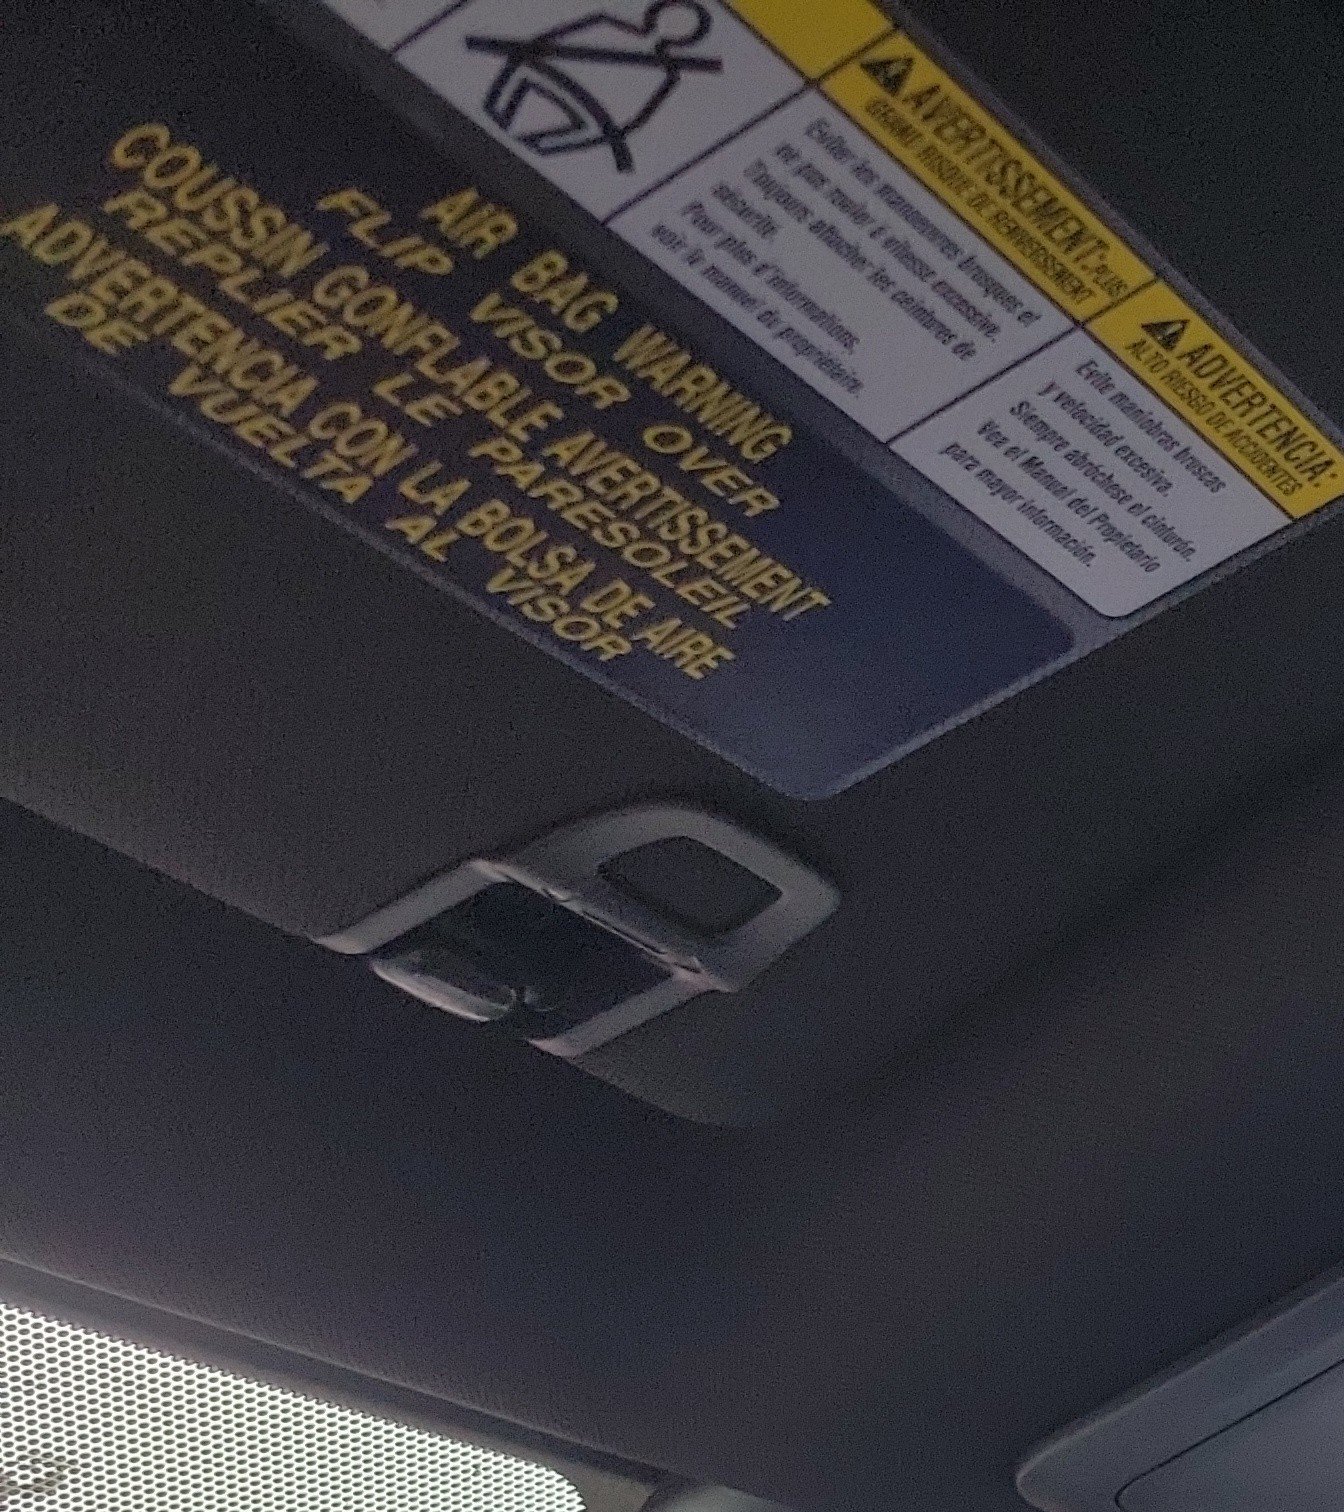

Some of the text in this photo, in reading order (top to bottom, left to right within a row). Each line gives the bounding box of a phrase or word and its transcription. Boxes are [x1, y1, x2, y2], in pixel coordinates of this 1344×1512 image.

[109, 123, 831, 623] COUSSIN GONFLABLE AVERTISSEMENT
[318, 188, 775, 515] FLIP VISOR OVER
[424, 186, 793, 461] AIR BAG WARNING
[1123, 337, 1171, 375] ALTO
[1204, 409, 1236, 433] DE
[0, 203, 731, 678] ADVERTENCIA CON LA BOLSA DE AIRE
[46, 285, 632, 659] DE VUELTA AL VISOR
[102, 185, 745, 630] REPLIER LE PARESOLEIL
[937, 440, 983, 473] para
[974, 466, 1026, 505] mayor
[1008, 398, 1071, 453] Siempre
[1062, 448, 1135, 506] abróchese
[1125, 501, 1153, 518] el
[1036, 379, 1062, 397] y
[1051, 389, 1126, 449] velocidad
[1107, 390, 1182, 453] maniobras
[1171, 445, 1227, 494] bruscas
[1174, 341, 1339, 489] ADVERTENCIA:
[976, 418, 1162, 574] Vea el Manual del Propietario
